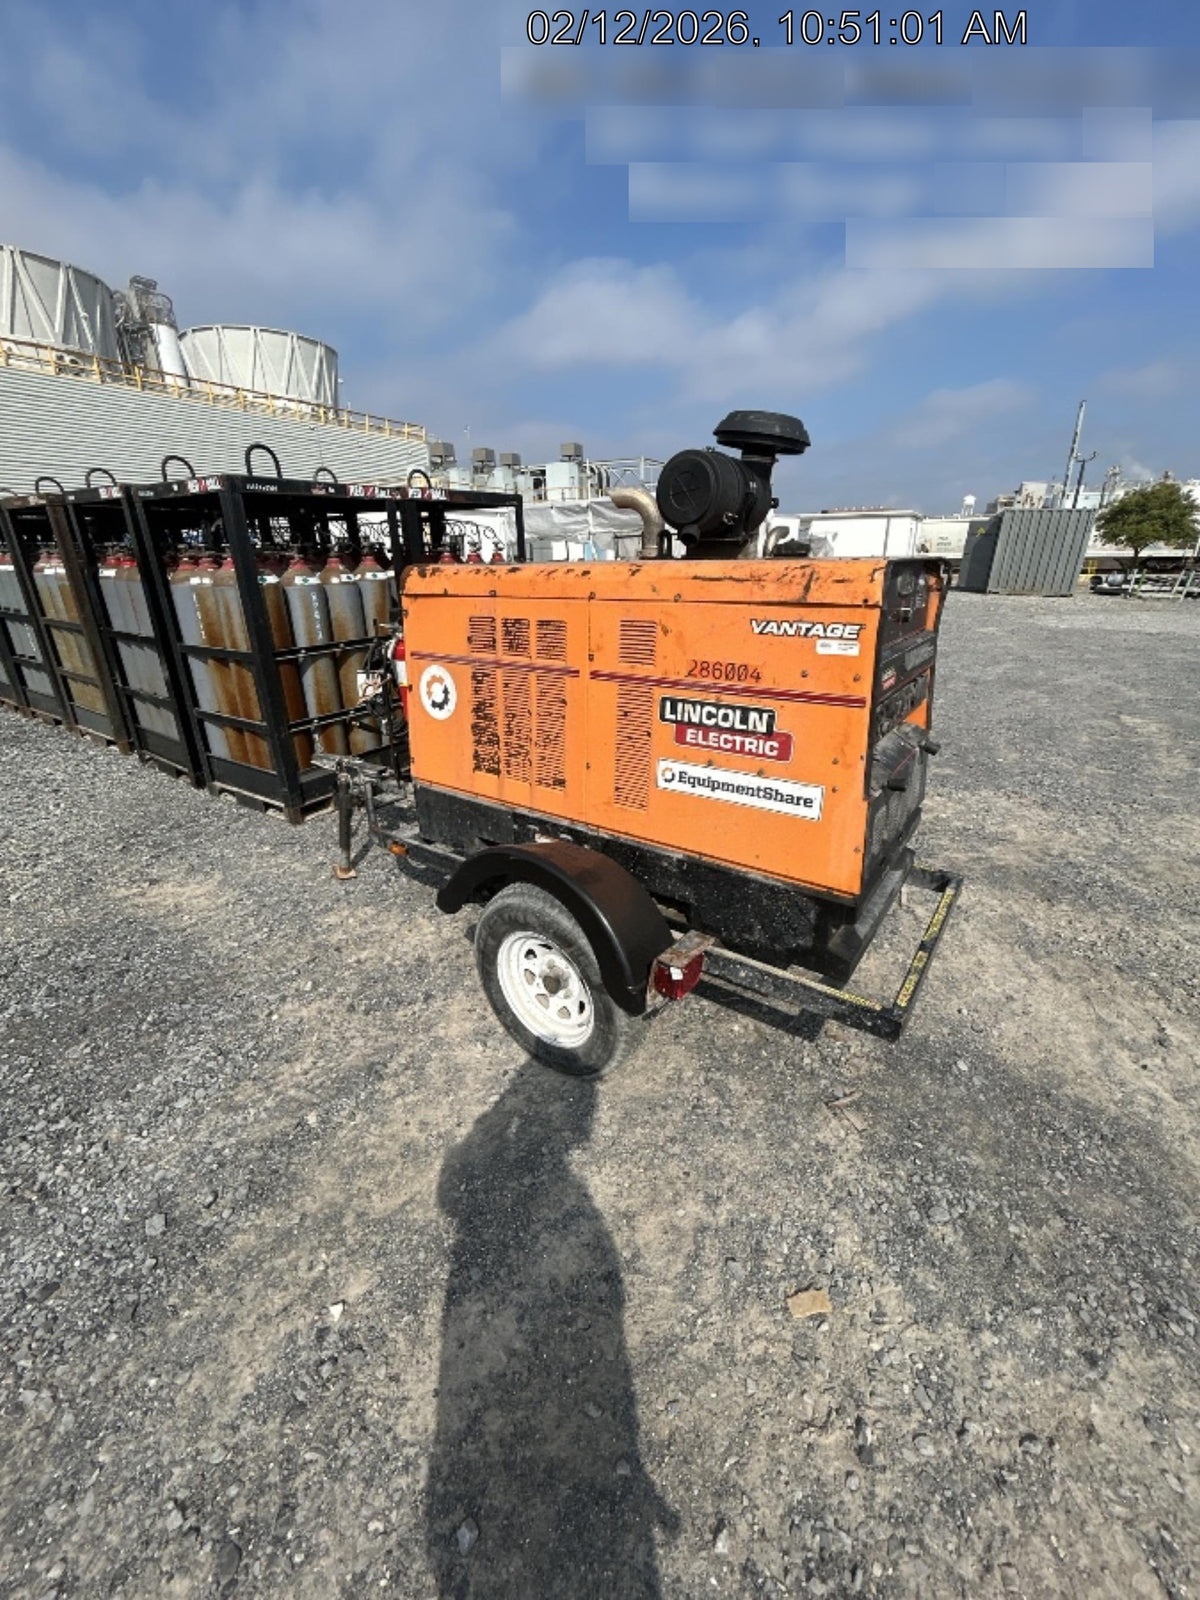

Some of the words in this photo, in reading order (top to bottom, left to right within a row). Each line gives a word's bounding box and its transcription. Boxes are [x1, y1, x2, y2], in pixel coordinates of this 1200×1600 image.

[751, 619, 862, 640] VANTAGE
[685, 659, 762, 683] 286004
[664, 699, 769, 733] LINCOLN
[685, 728, 779, 756] ELECTRIC
[677, 771, 814, 808] EquipmentShare
